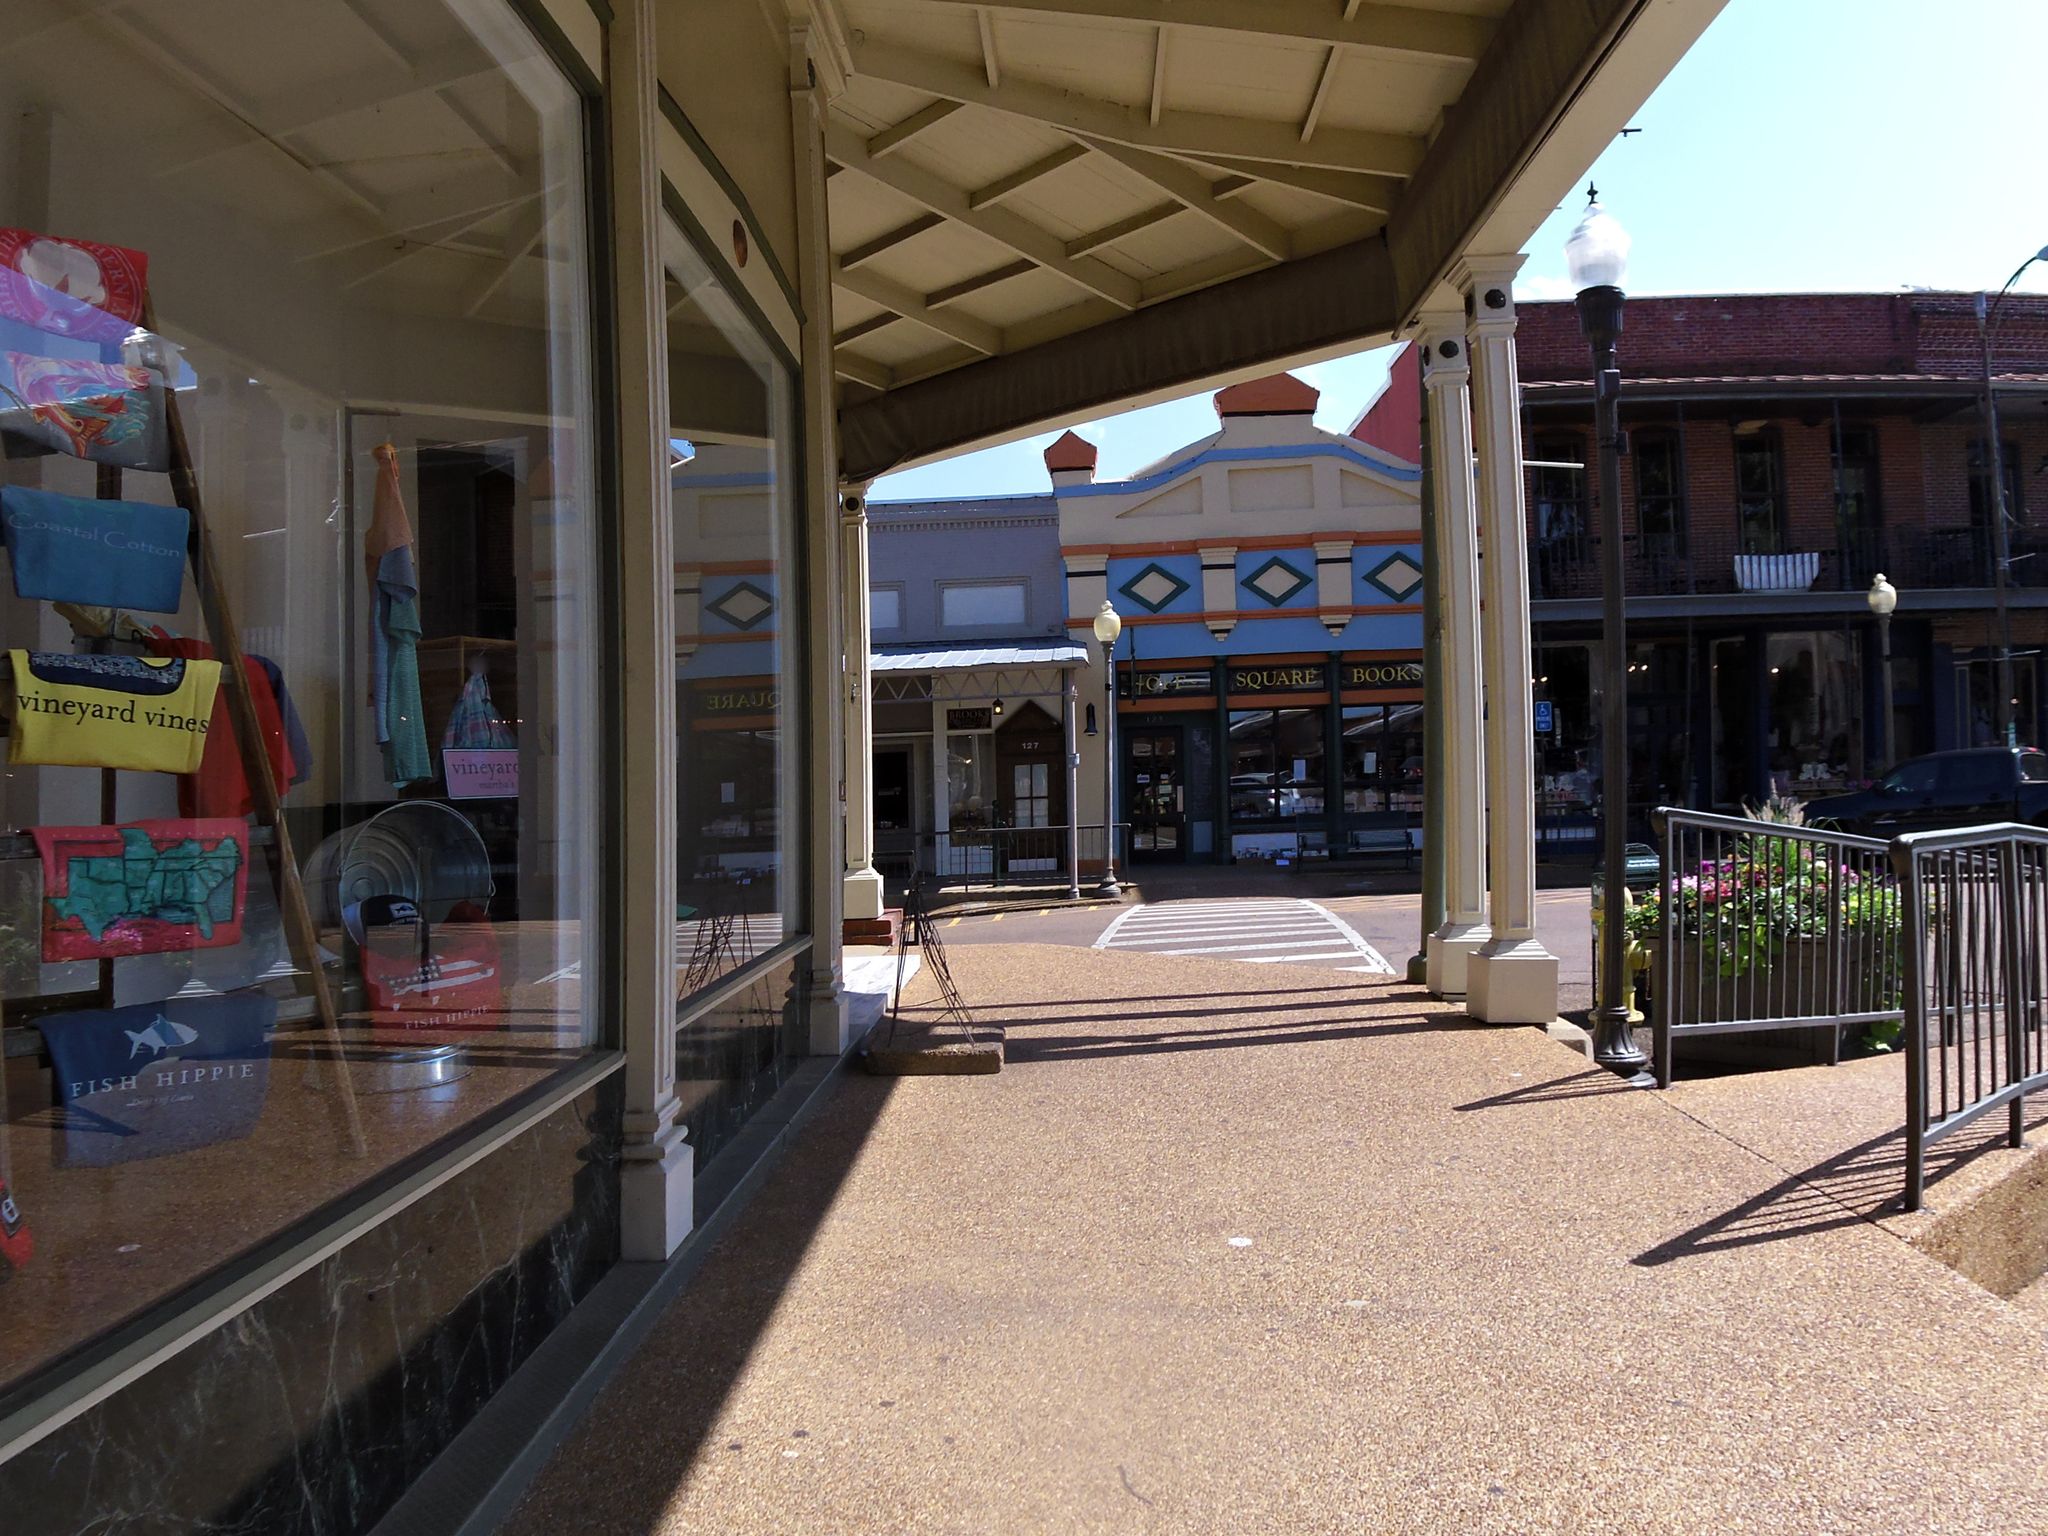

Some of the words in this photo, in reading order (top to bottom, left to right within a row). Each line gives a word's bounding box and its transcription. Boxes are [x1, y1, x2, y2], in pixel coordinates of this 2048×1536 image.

[8, 512, 98, 541] Coastal
[104, 531, 180, 557] Cotton
[1236, 668, 1318, 690] SQUARE
[1352, 666, 1422, 683] BOOKS
[17, 691, 135, 725] vineyard
[145, 707, 209, 734] vines
[1022, 742, 1040, 750] 127
[405, 1016, 440, 1030] FISH
[71, 1075, 137, 1097] FISH
[157, 1064, 254, 1087] HIPPIE
